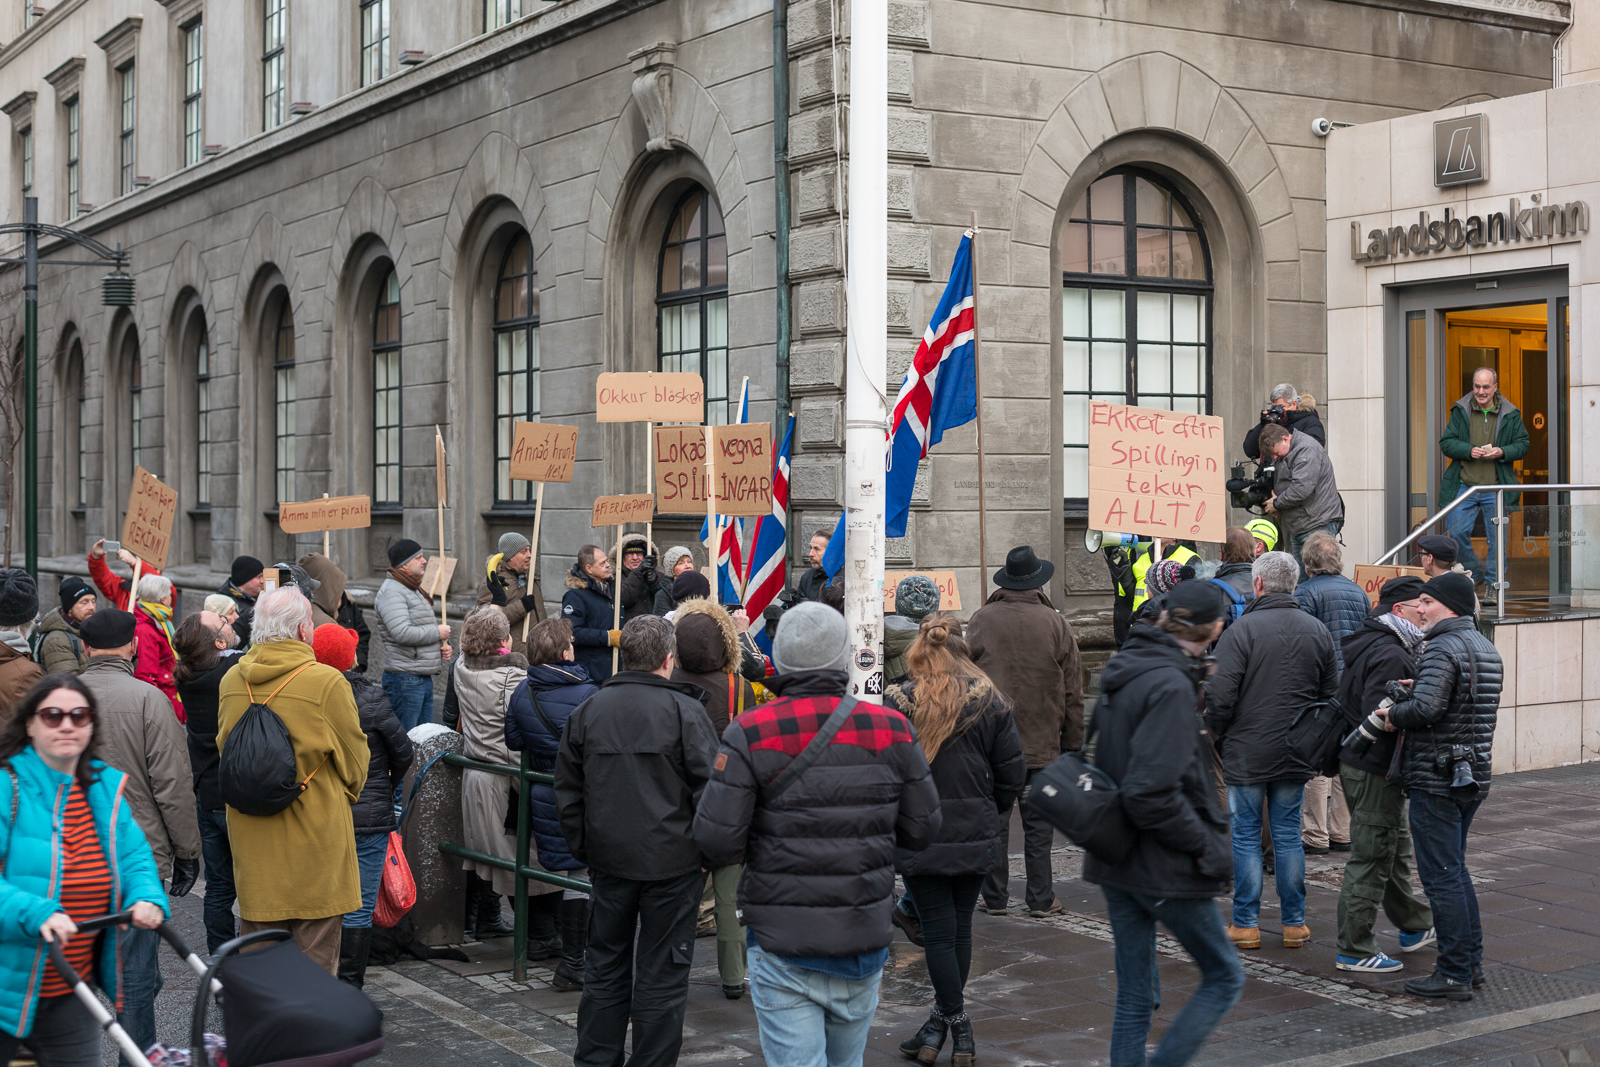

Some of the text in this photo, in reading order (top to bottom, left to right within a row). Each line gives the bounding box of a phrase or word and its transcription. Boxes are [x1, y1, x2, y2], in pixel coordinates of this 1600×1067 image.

[1350, 193, 1590, 261] Landsbankinn
[599, 388, 648, 404] Okkur
[512, 432, 577, 464] Annað hrun?
[720, 437, 764, 465] vegna
[1111, 439, 1218, 477] Spillingin
[544, 463, 567, 479] Nei!
[1125, 472, 1204, 499] tekur
[280, 507, 309, 522] Amma
[328, 508, 338, 518] er
[1104, 497, 1207, 534] ALLT!
